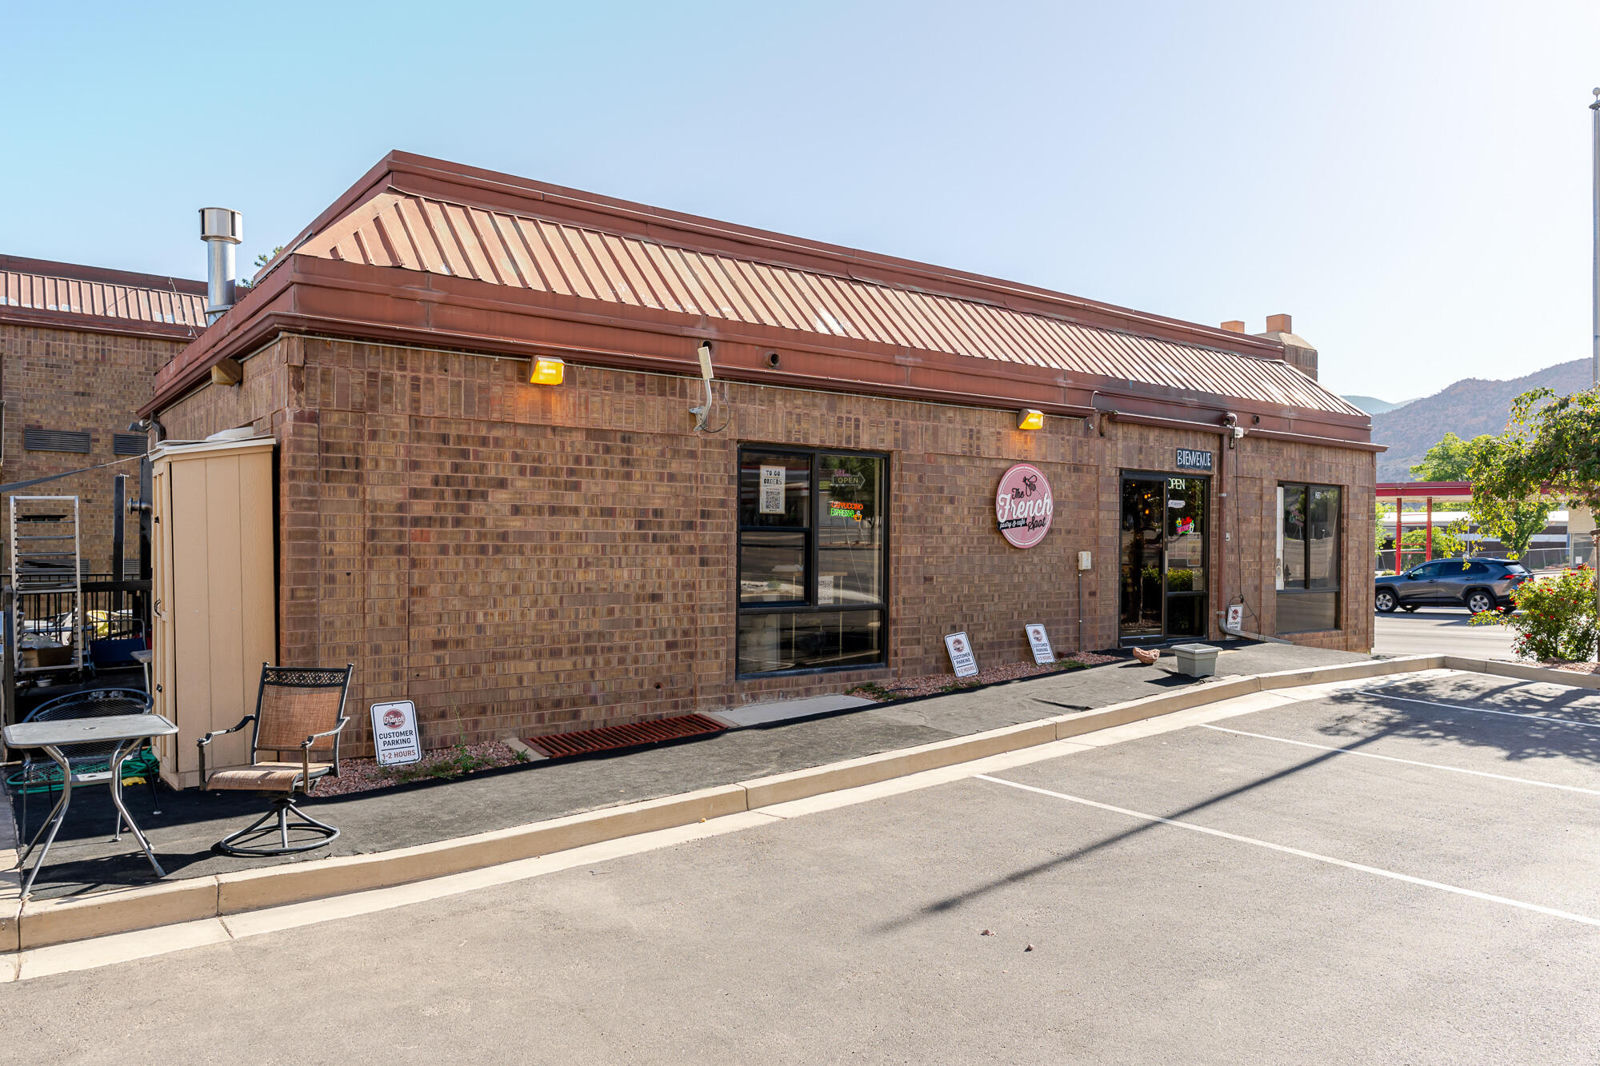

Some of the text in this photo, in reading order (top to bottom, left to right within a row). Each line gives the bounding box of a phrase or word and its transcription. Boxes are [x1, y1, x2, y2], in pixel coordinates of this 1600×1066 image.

[1177, 450, 1211, 466] BIENVENUE
[1168, 478, 1186, 490] OPEN
[1012, 488, 1024, 499] The
[998, 493, 1053, 522] French
[1028, 516, 1046, 532] Spot
[953, 652, 970, 660] CUSTOMER
[378, 730, 414, 740] CUSTOMER
[382, 738, 412, 746] PARKING
[394, 750, 416, 758] HOURS
